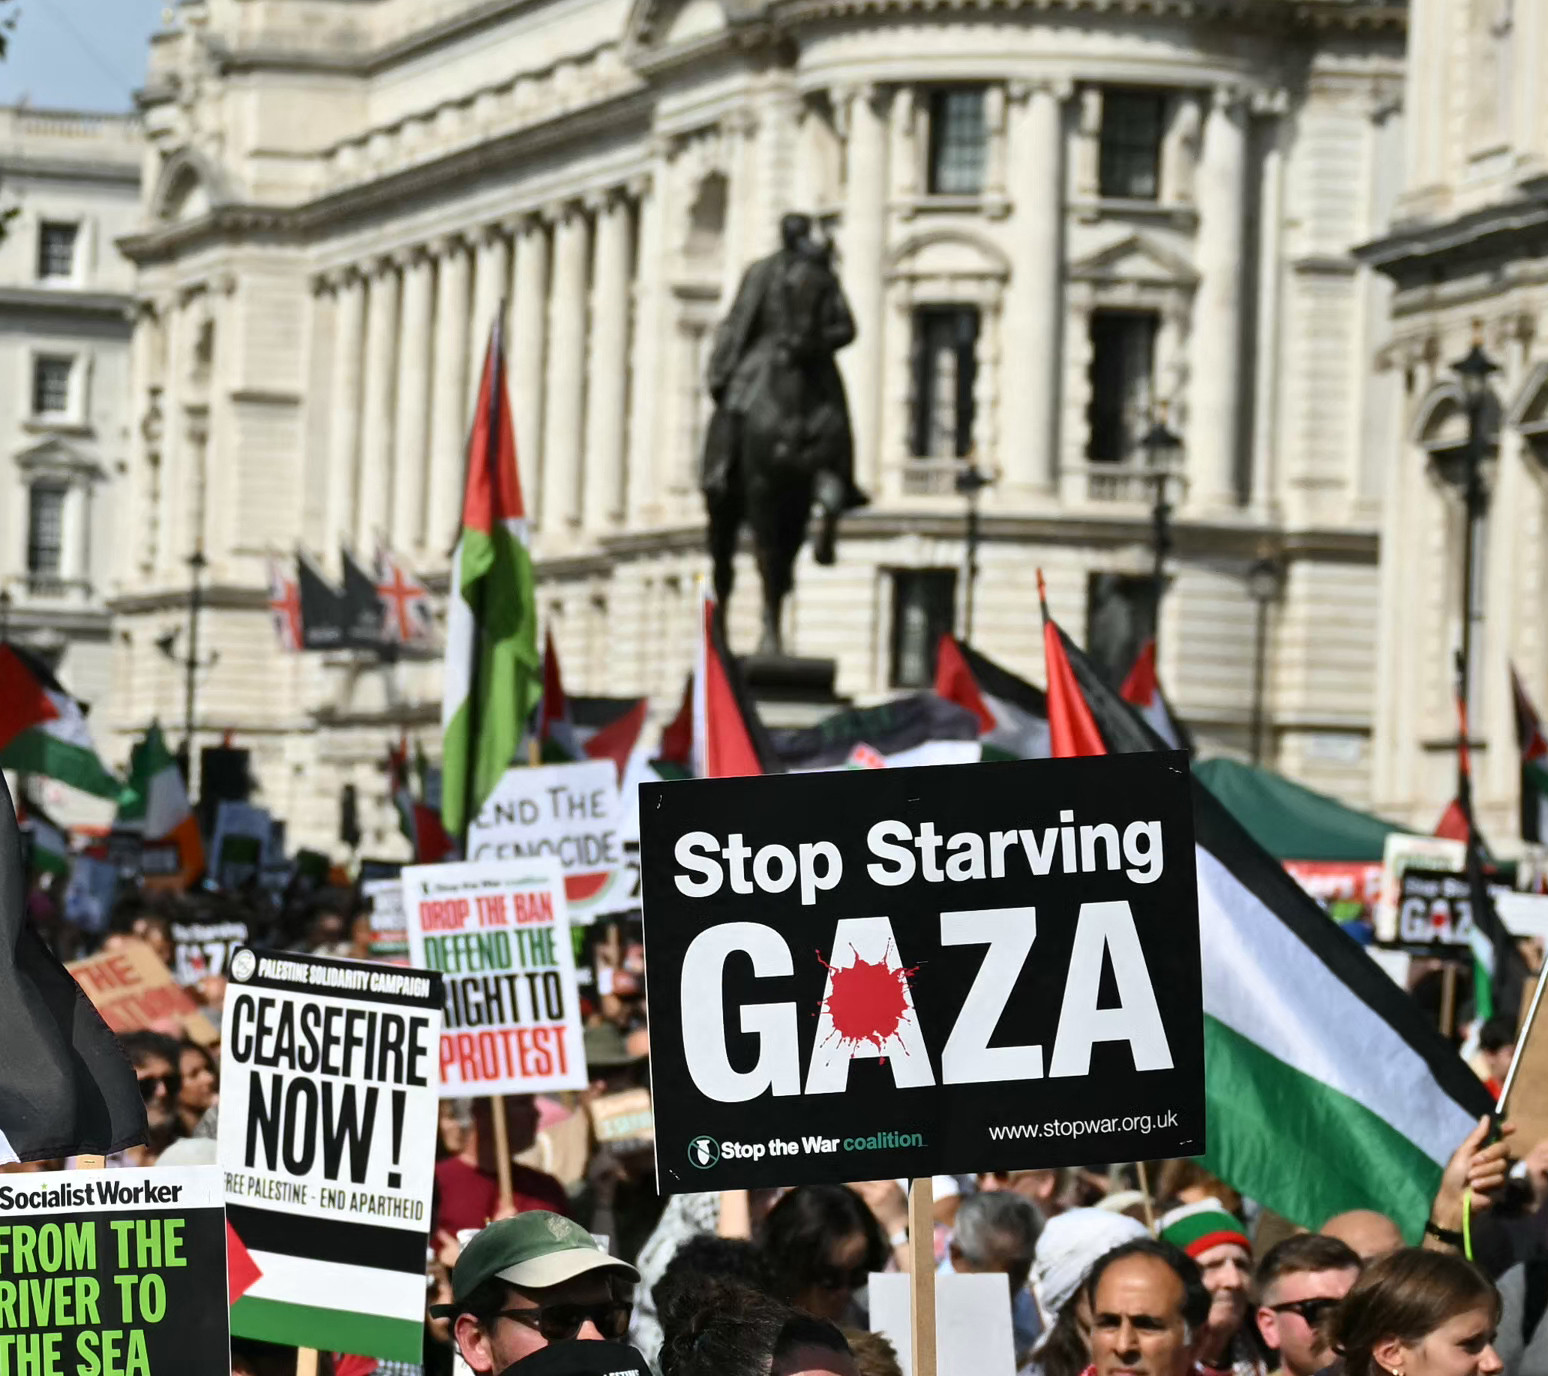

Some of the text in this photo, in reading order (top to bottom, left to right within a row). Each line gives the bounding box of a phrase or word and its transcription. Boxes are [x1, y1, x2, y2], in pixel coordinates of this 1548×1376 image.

[546, 785, 607, 819] THE
[673, 830, 844, 906] Stop
[866, 809, 1165, 887] Starving
[420, 890, 554, 932] DROP THE BAN
[423, 926, 559, 973] DEFEND THE
[258, 957, 431, 999] PALESTINE SOLIDARITY CAMPAIGN
[524, 971, 565, 1022] TO
[680, 899, 1175, 1105] GAZA
[230, 993, 430, 1087] CEASEFIRE
[440, 1026, 568, 1084] PROTEST
[720, 1130, 923, 1161] Stop the War coalition
[989, 1109, 1179, 1142] www.stopwar.org.uk
[96, 1179, 183, 1206] Worker
[247, 1176, 308, 1204] PALESTINE
[320, 1187, 346, 1211] END
[350, 1191, 424, 1221] APARTHEID
[110, 1218, 188, 1269] THE
[113, 1273, 167, 1324] TO
